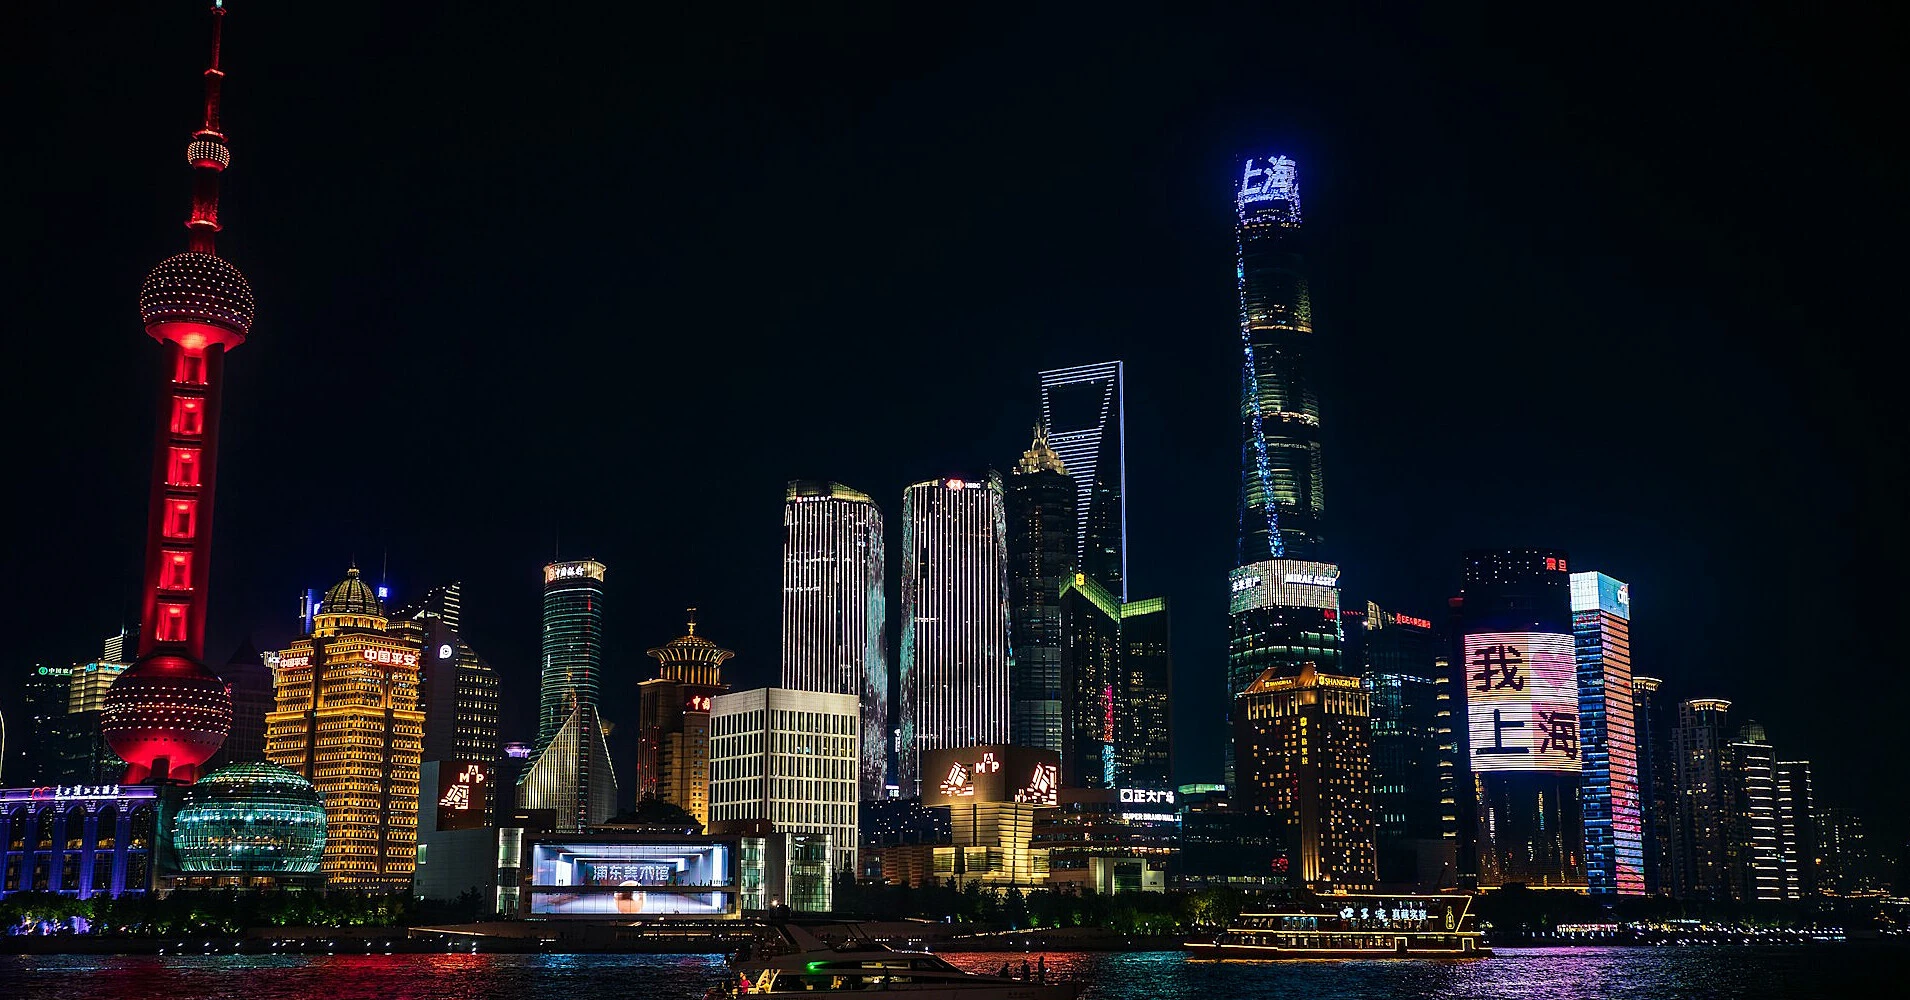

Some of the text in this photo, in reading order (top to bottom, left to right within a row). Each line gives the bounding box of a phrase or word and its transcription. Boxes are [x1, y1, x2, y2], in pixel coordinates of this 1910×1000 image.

[1240, 155, 1296, 195] 上海
[1546, 557, 1567, 571] 震旦
[1285, 573, 1337, 587] MIRAE ASSET
[279, 657, 309, 668] 中国平安
[363, 649, 417, 667] 中国平安
[1472, 644, 1524, 692] 我
[1475, 708, 1579, 761] 上海
[1133, 789, 1175, 804] 正大广场
[592, 865, 670, 881] 浦东美术馆
